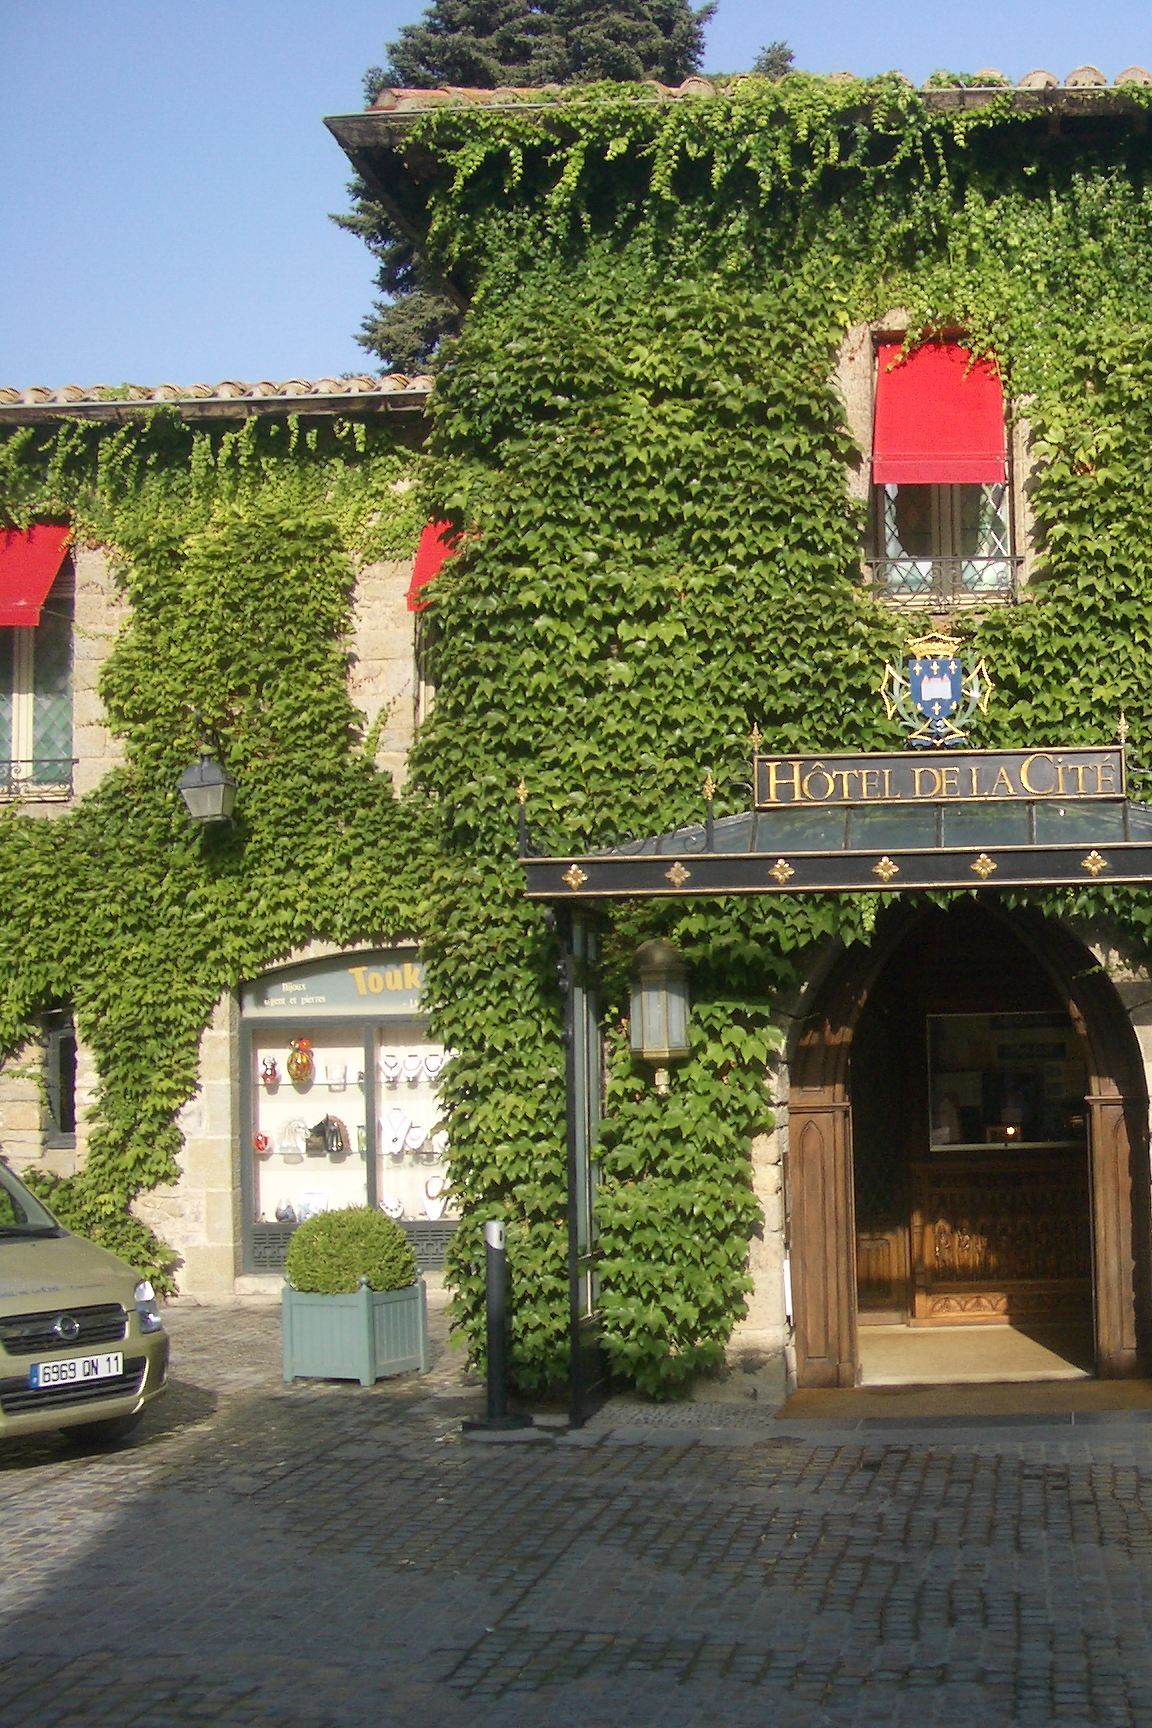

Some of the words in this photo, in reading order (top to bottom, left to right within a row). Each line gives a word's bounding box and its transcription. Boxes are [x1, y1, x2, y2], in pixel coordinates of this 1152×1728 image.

[765, 761, 901, 802] HÔTEL
[911, 767, 960, 798] DE
[969, 766, 1017, 796] LA
[289, 996, 297, 1005] et
[42, 1362, 76, 1383] 6969
[83, 1359, 98, 1377] QN
[106, 1355, 119, 1374] 11
